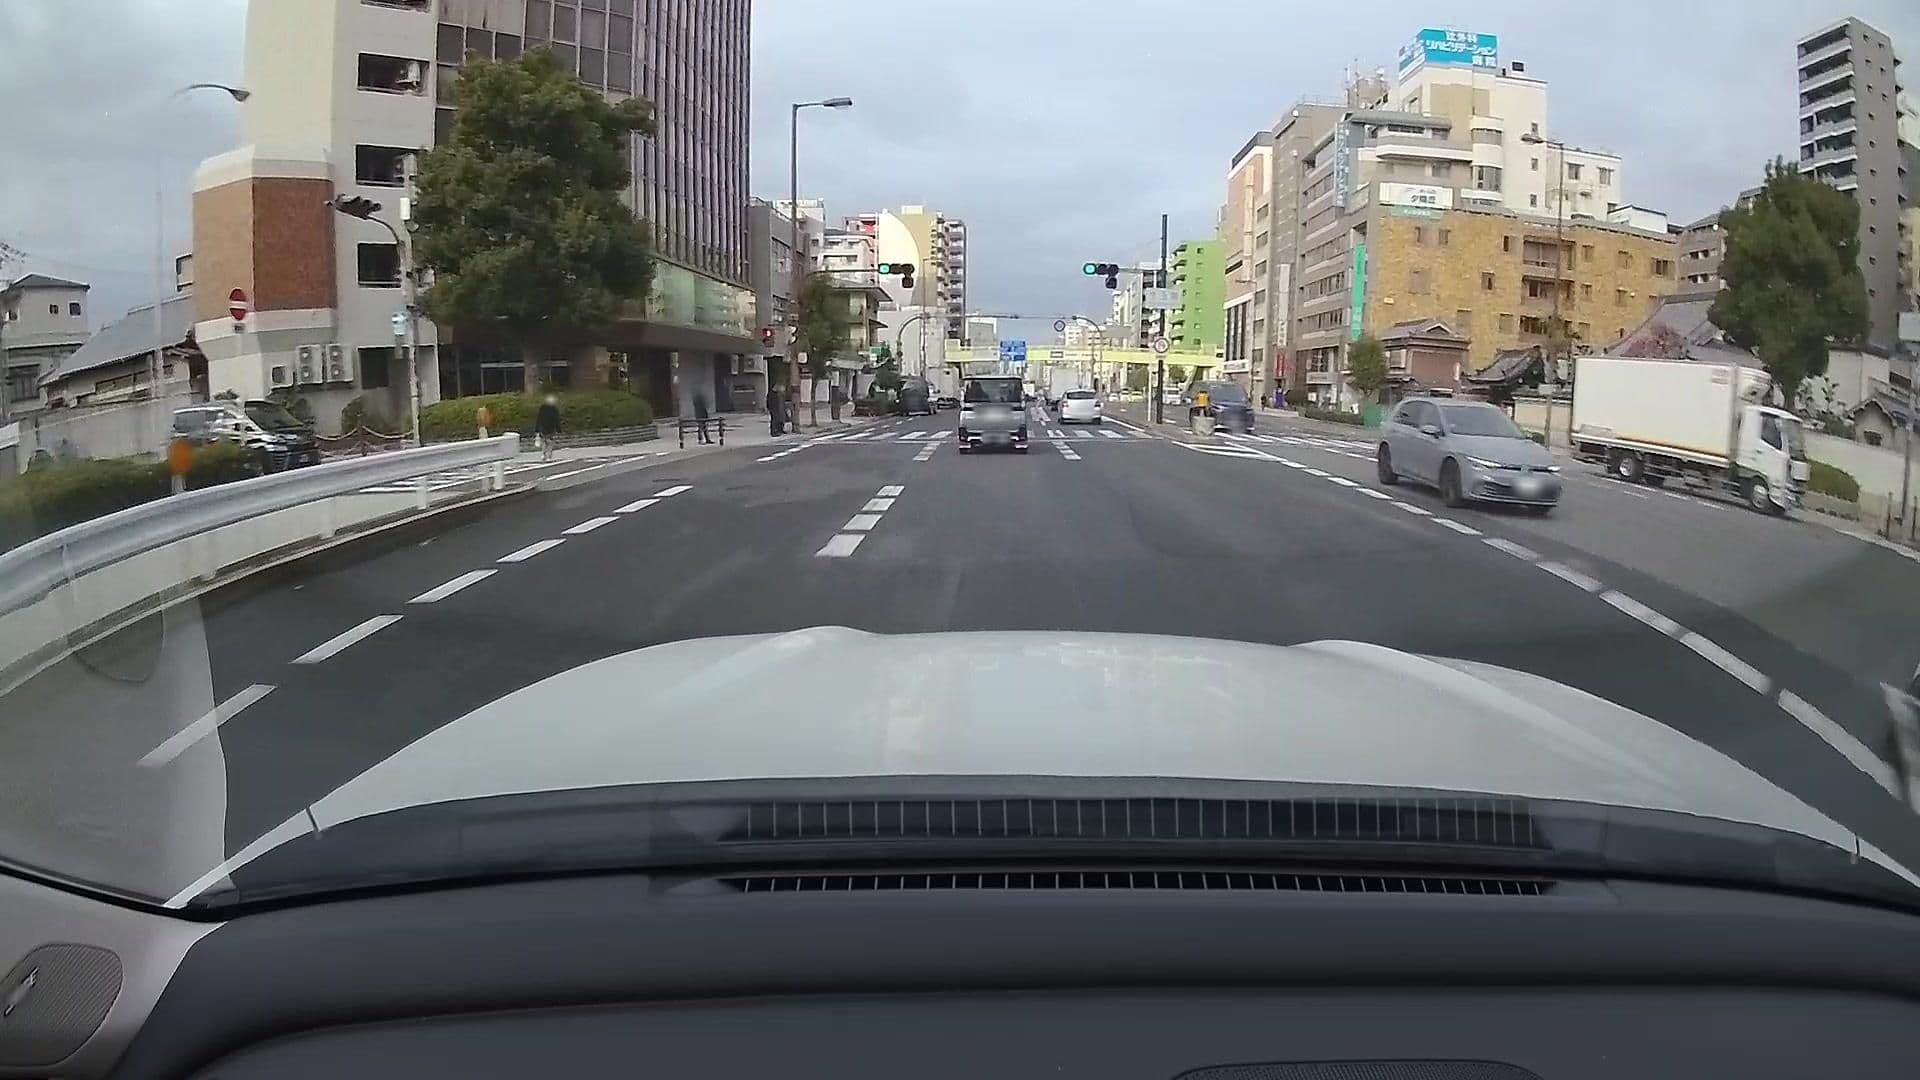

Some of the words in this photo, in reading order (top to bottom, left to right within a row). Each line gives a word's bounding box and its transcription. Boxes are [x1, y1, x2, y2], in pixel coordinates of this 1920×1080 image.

[1425, 40, 1497, 55] リハビリテーション
